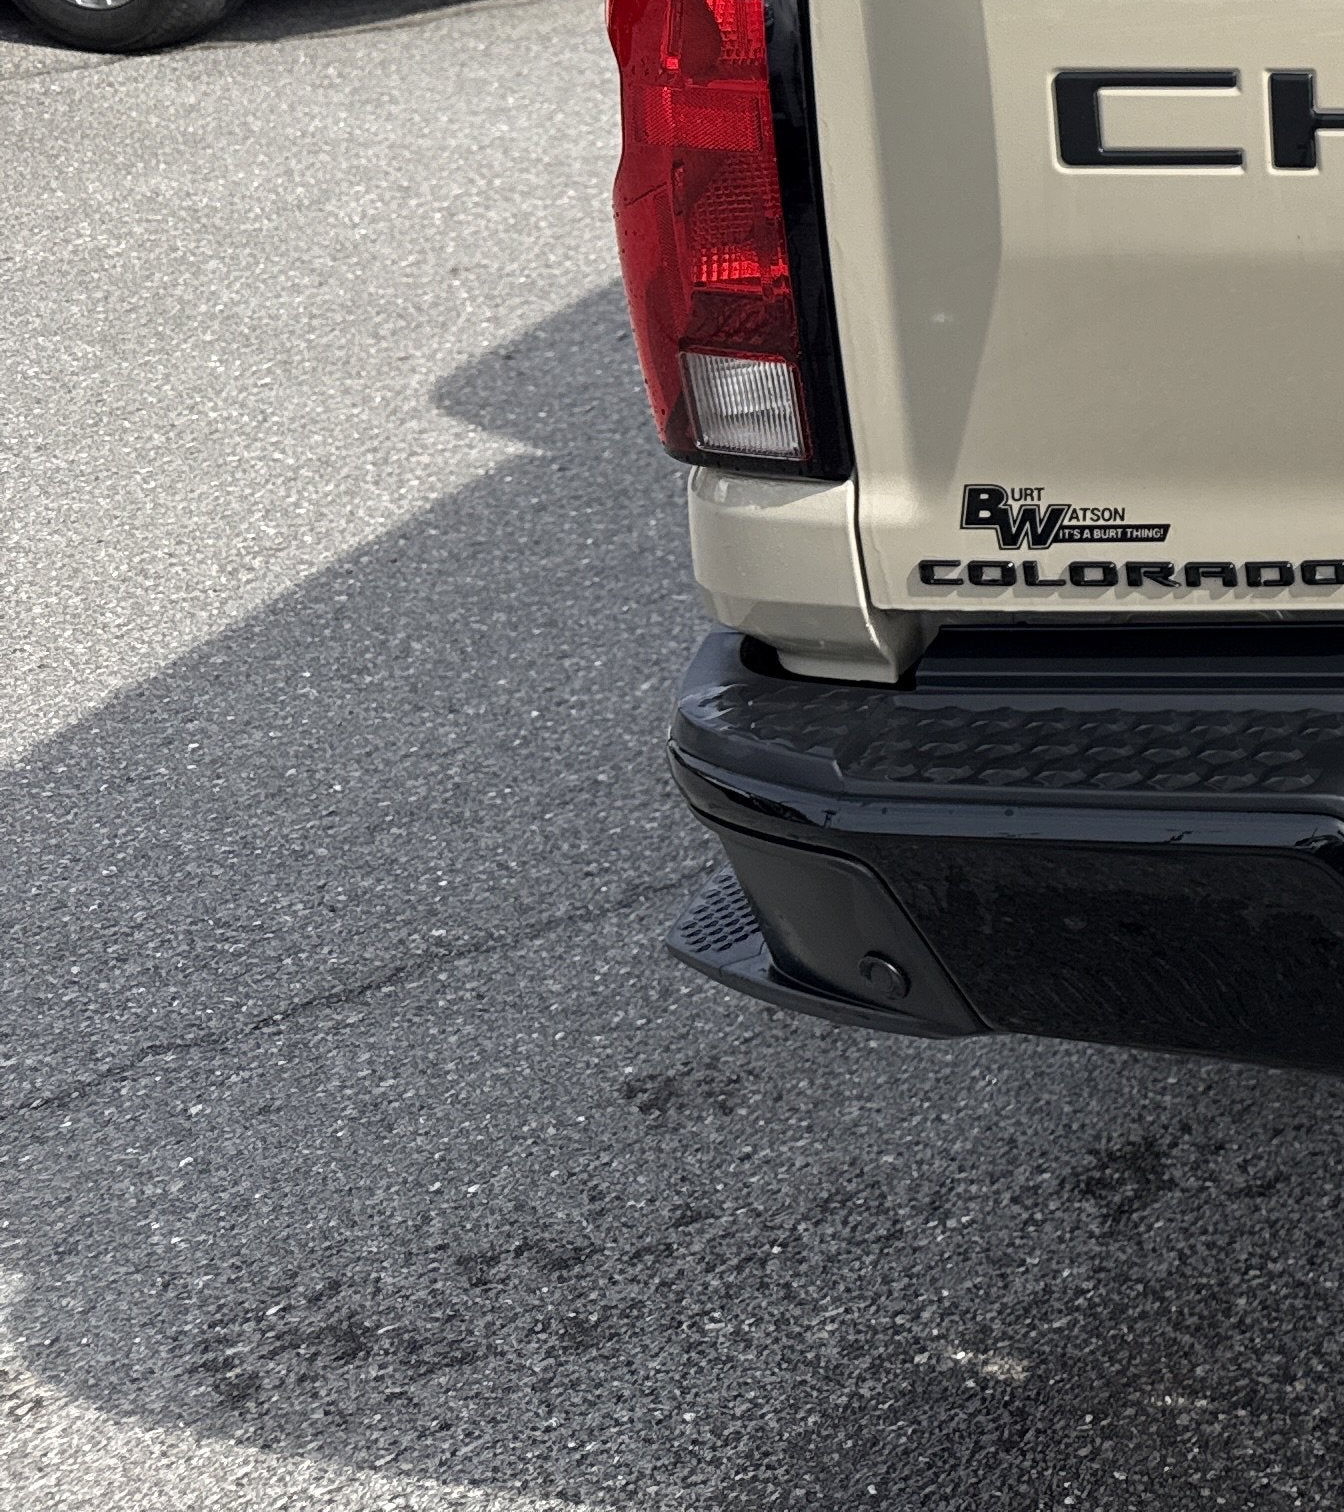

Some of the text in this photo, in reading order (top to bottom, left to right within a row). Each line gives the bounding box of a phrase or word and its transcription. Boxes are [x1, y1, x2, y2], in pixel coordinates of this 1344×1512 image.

[1059, 528, 1164, 540] IT'S A BURT THING!
